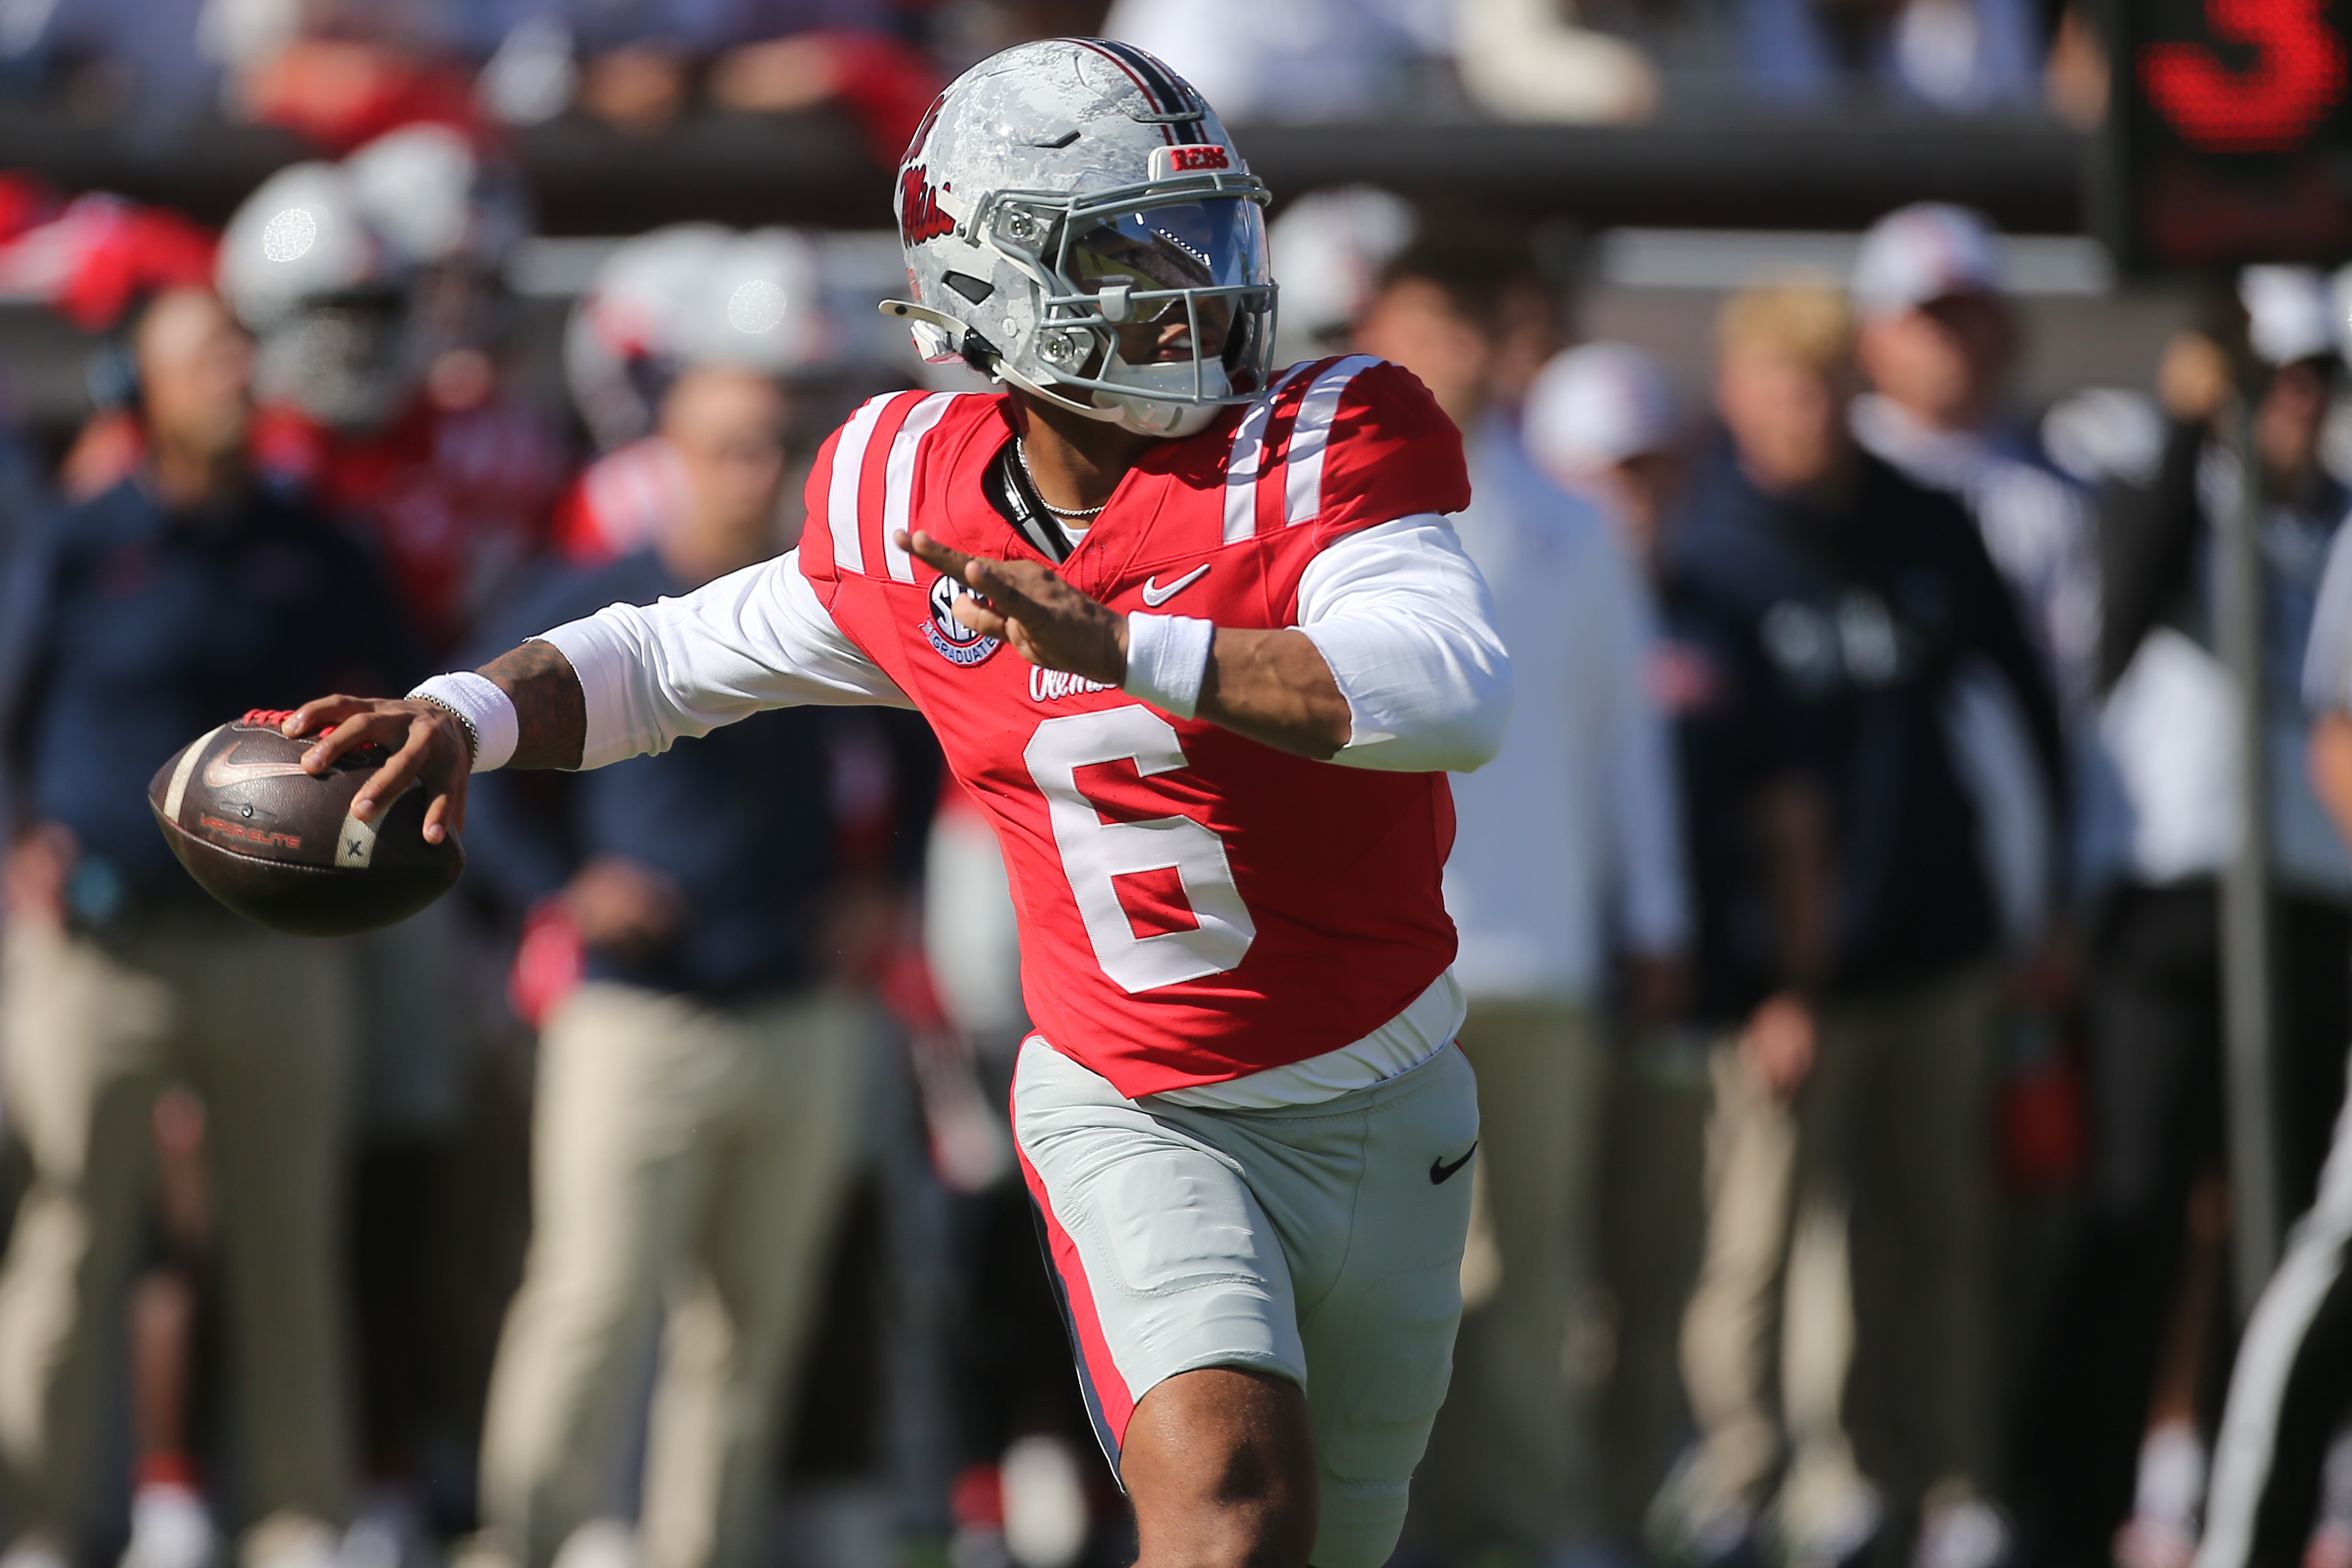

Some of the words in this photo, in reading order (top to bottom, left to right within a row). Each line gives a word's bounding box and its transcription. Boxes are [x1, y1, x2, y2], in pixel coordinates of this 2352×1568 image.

[1169, 147, 1228, 171] REBS
[933, 636, 995, 663] GRADUATE
[248, 830, 301, 848] ELITE
[1023, 703, 1257, 994] 6
